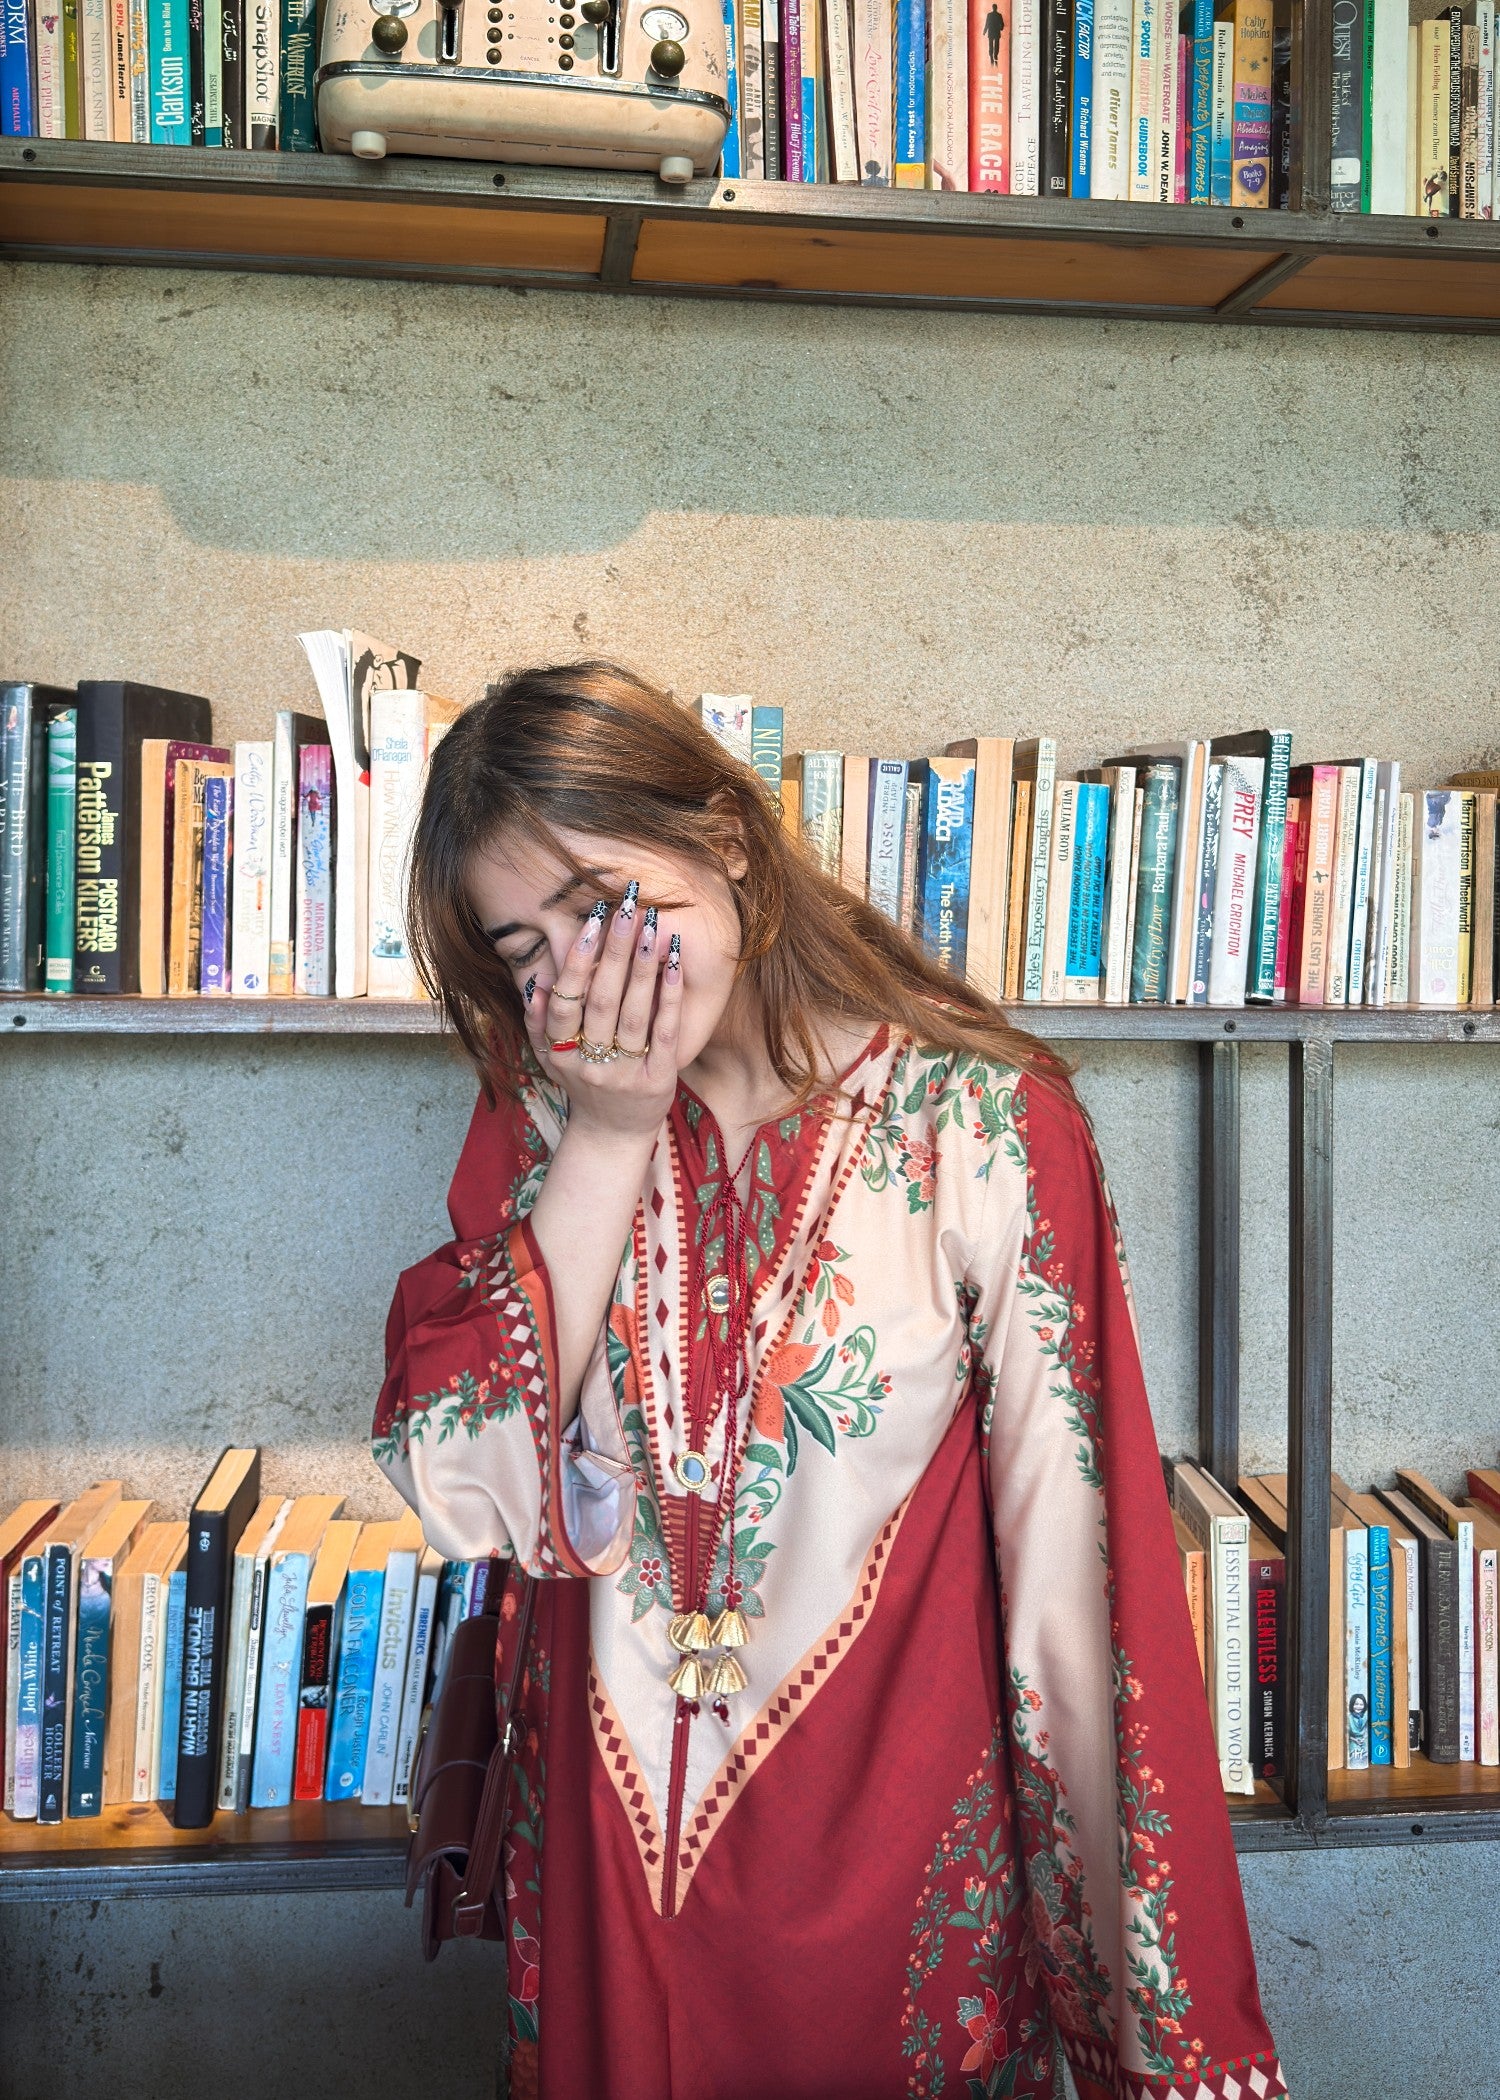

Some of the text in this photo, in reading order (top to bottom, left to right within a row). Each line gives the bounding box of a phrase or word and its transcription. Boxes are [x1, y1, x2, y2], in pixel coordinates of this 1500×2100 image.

[789, 15, 799, 35] Tales
[1140, 20, 1151, 58] SPORTS
[1240, 27, 1270, 39] Hopkins
[1245, 15, 1267, 29] Cathy
[41, 44, 53, 118] Child Play
[117, 32, 126, 99] James Herriot
[155, 37, 184, 126] Clarkson Born
[252, 5, 275, 103] SnapShot
[284, 33, 311, 99] WANDERLUST
[1017, 41, 1032, 123] TRAVELLING
[1053, 30, 1065, 76] Ladybug,
[1432, 45, 1440, 64] Helen
[12, 87, 21, 132] MICHALUK
[90, 33, 104, 132] JENNY TOMLIN
[209, 73, 219, 122] THE TEMPEST
[907, 98, 915, 108] for
[1077, 21, 1090, 175] FACTOR Dr Richard Wiseman
[1160, 1, 1173, 202] WORSE WATERGATE JOHN W. DEAN
[1194, 58, 1210, 122] Desperate
[1216, 29, 1226, 146] Rule Britannia Maurier
[790, 123, 800, 148] Hilary
[907, 130, 916, 158] theory
[979, 73, 1003, 182] THE RACE
[1107, 88, 1121, 169] Oliver James
[1138, 117, 1149, 176] GUIDEBOOK
[1486, 133, 1494, 158] Legend
[1465, 161, 1475, 209] SIMPSON
[12, 757, 27, 796] THE
[882, 780, 890, 814] ANDREA
[949, 781, 965, 828] DAVID
[1264, 744, 1289, 825] GROTESQUE
[11, 809, 26, 857] BIRD
[55, 830, 67, 849] Fred
[78, 761, 112, 874] Patterson
[101, 809, 118, 846] James
[878, 822, 894, 860] Rose
[1058, 789, 1072, 861] WILLIAM BOYD
[1073, 845, 1082, 870] RANCH
[1083, 860, 1091, 892] HOLLOW
[1094, 856, 1102, 879] JUMP
[1151, 812, 1170, 893] Barbara Paul
[1227, 790, 1256, 957] PREY MICHAEL CRICHTON
[1352, 766, 1375, 989] HOMEBIRD Terence Blacker Piccadilly
[1459, 799, 1473, 933] Harry Harrison Wheelworld
[77, 879, 98, 953] KILLERS
[98, 878, 118, 953] POSTCARD
[938, 881, 955, 942] The Sixth
[1025, 809, 1050, 991] Ryle's Expository Thoughts
[1071, 871, 1080, 907] SHADOW
[1071, 908, 1079, 919] OF
[1091, 911, 1098, 922] AT
[1307, 789, 1332, 990] THE LAST SUNRISE ROBERT RYAN
[303, 898, 312, 956] DICKINSON
[315, 902, 324, 952] MIRANDA
[1070, 920, 1078, 949] SECRET
[1080, 919, 1089, 955] MESSAGE
[1090, 923, 1098, 957] MYSTERY
[1198, 920, 1206, 947] TAMSYN
[1261, 883, 1279, 965] PATRICK McGRATH
[1333, 975, 1343, 999] PICADOR
[1189, 1560, 1199, 1585] Daphne
[1372, 1529, 1380, 1565] SUMMERS
[1379, 1533, 1387, 1558] LAURA
[473, 1568, 489, 1600] Camden
[1350, 1583, 1366, 1609] Girl
[1483, 1579, 1493, 1617] CATHERINE
[50, 1557, 66, 1673] POINT RETREAT
[142, 1577, 158, 1672] GROW COOK
[412, 1607, 430, 1679] FIBRENETICS GILLY
[1483, 1617, 1493, 1652] COOKSON
[185, 1607, 203, 1687] BRUNDLE
[339, 1583, 369, 1717] COLIN FALCONER
[377, 1588, 409, 1755] invictus JOHN CARLIN
[1224, 1549, 1244, 1783] ESSENTIAL GUIDE TO WORD
[1255, 1589, 1277, 1759] RELENTLESS SIMON KERNICK
[1371, 1584, 1387, 1716] Desperate Measures
[21, 1641, 40, 1714] John White
[195, 1606, 216, 1756] WORKING THE WHEEL
[181, 1688, 199, 1755] MARTIN
[272, 1682, 286, 1756] LOVE NEST
[349, 1695, 369, 1768] Rough Justice
[43, 1727, 54, 1781] HOOVER
[52, 1723, 64, 1781] COLLEEN
